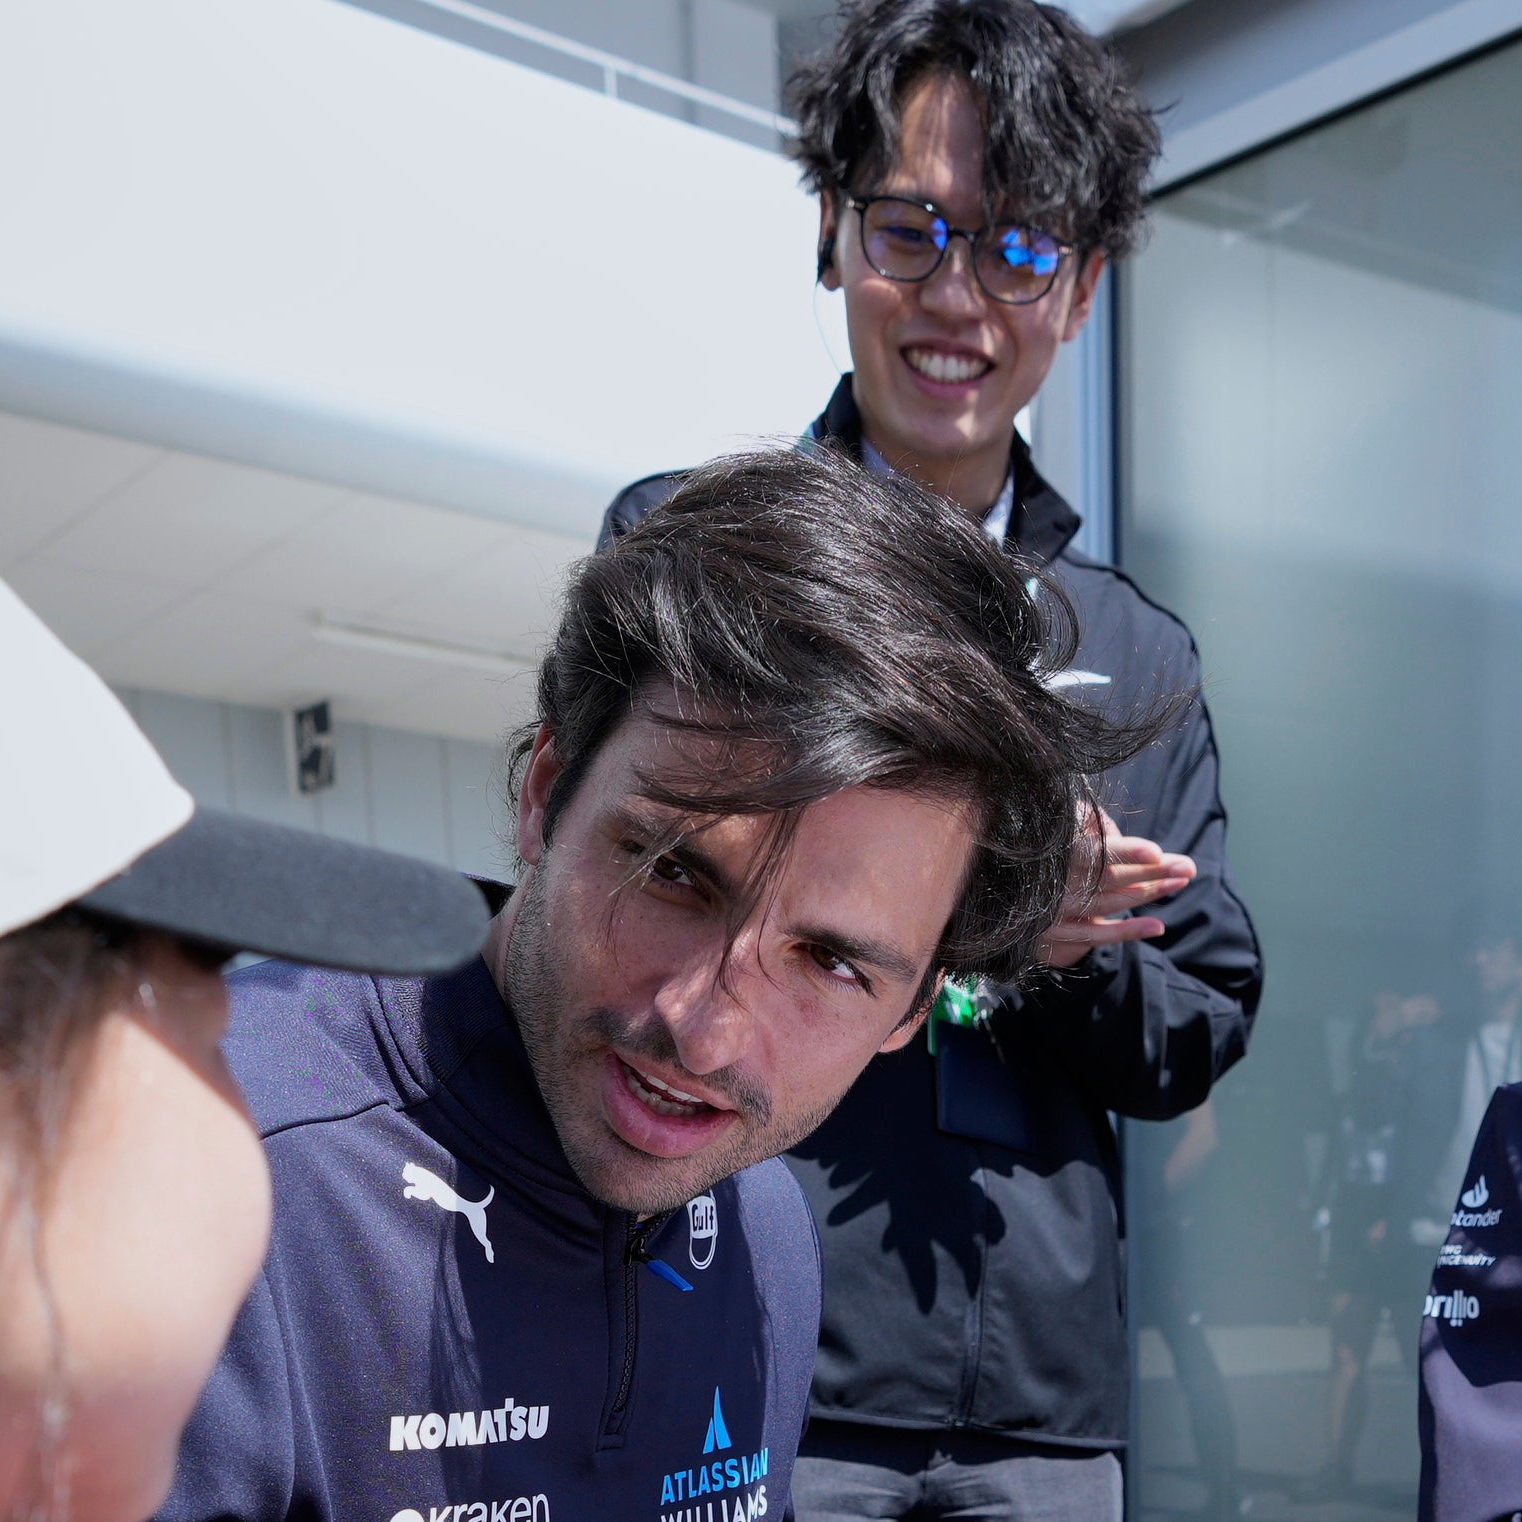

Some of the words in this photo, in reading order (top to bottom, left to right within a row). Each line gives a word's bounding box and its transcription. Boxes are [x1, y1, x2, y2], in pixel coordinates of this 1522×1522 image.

[691, 1203, 714, 1232] Gulf
[388, 1397, 550, 1452] KOMATSU
[659, 1447, 770, 1506] ATLASSIAN
